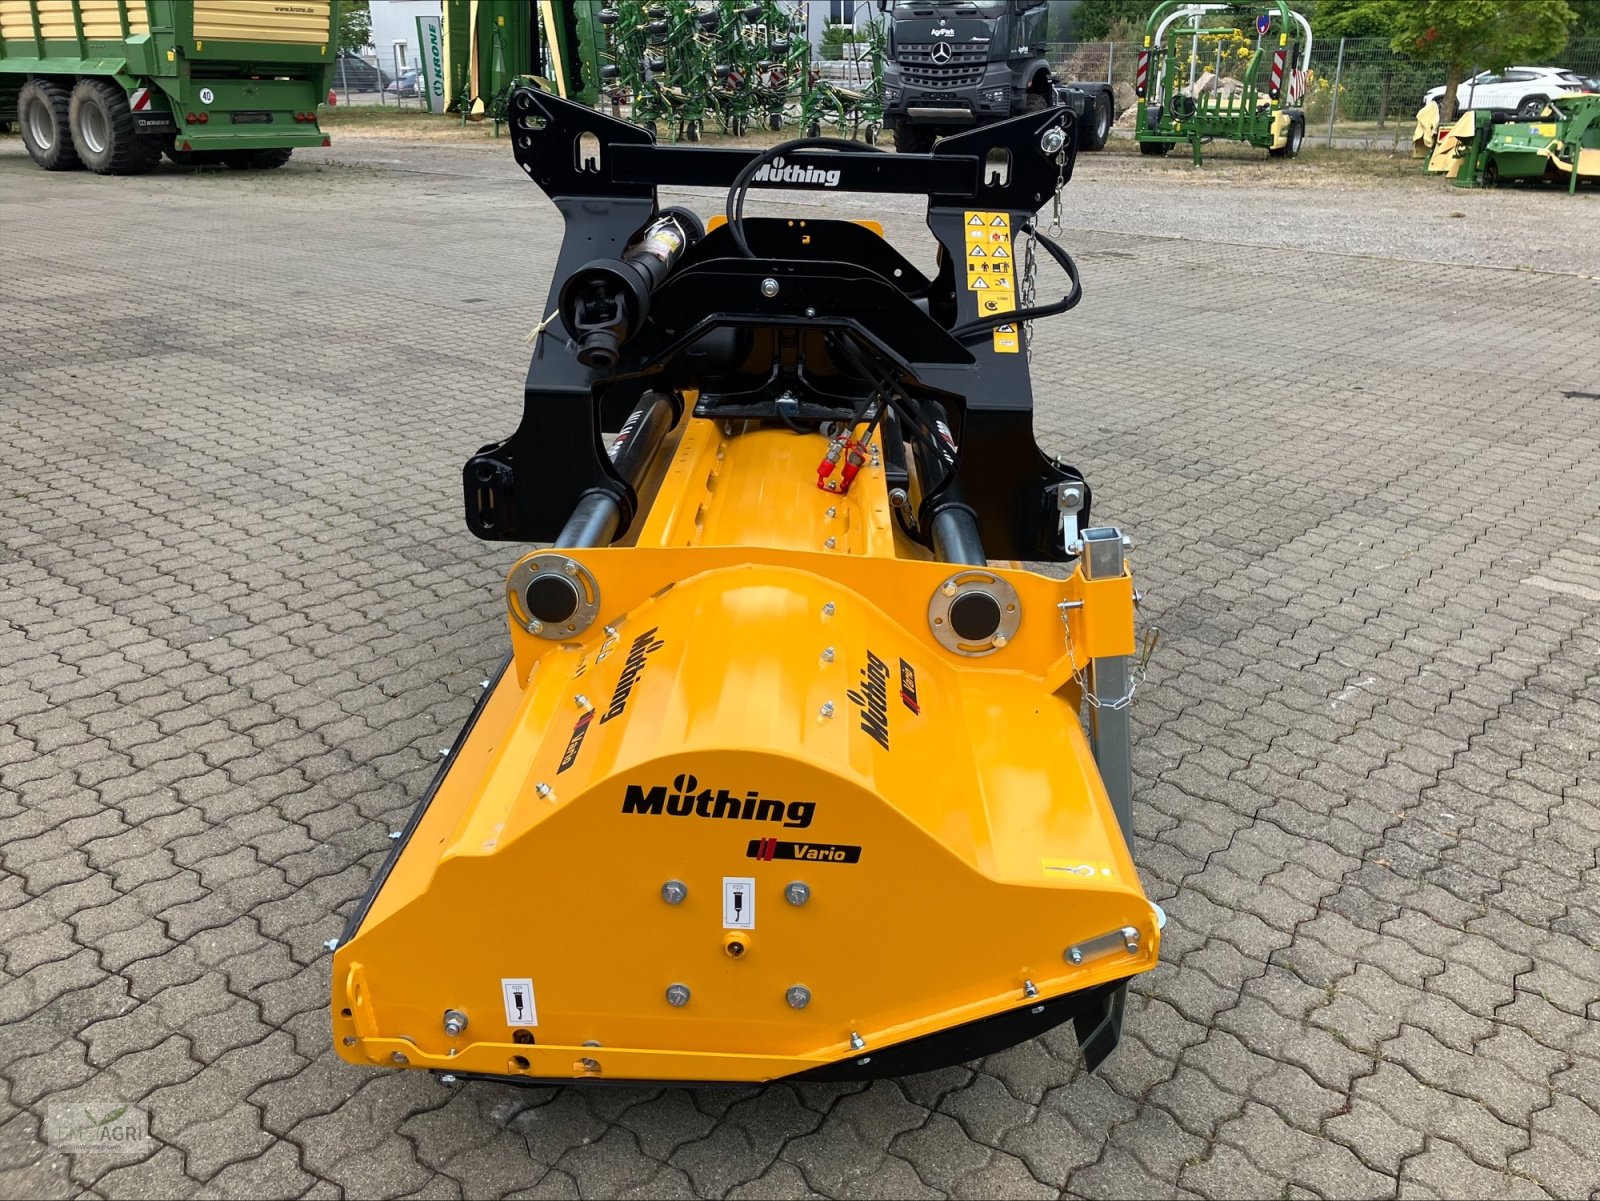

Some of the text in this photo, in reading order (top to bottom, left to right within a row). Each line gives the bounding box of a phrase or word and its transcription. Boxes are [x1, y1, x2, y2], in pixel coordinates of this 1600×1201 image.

[931, 28, 955, 37] AgriPark
[428, 24, 442, 79] KRONE
[202, 91, 212, 101] 40
[902, 667, 915, 694] Vario
[561, 731, 586, 766] Vario
[793, 844, 846, 862] Vario
